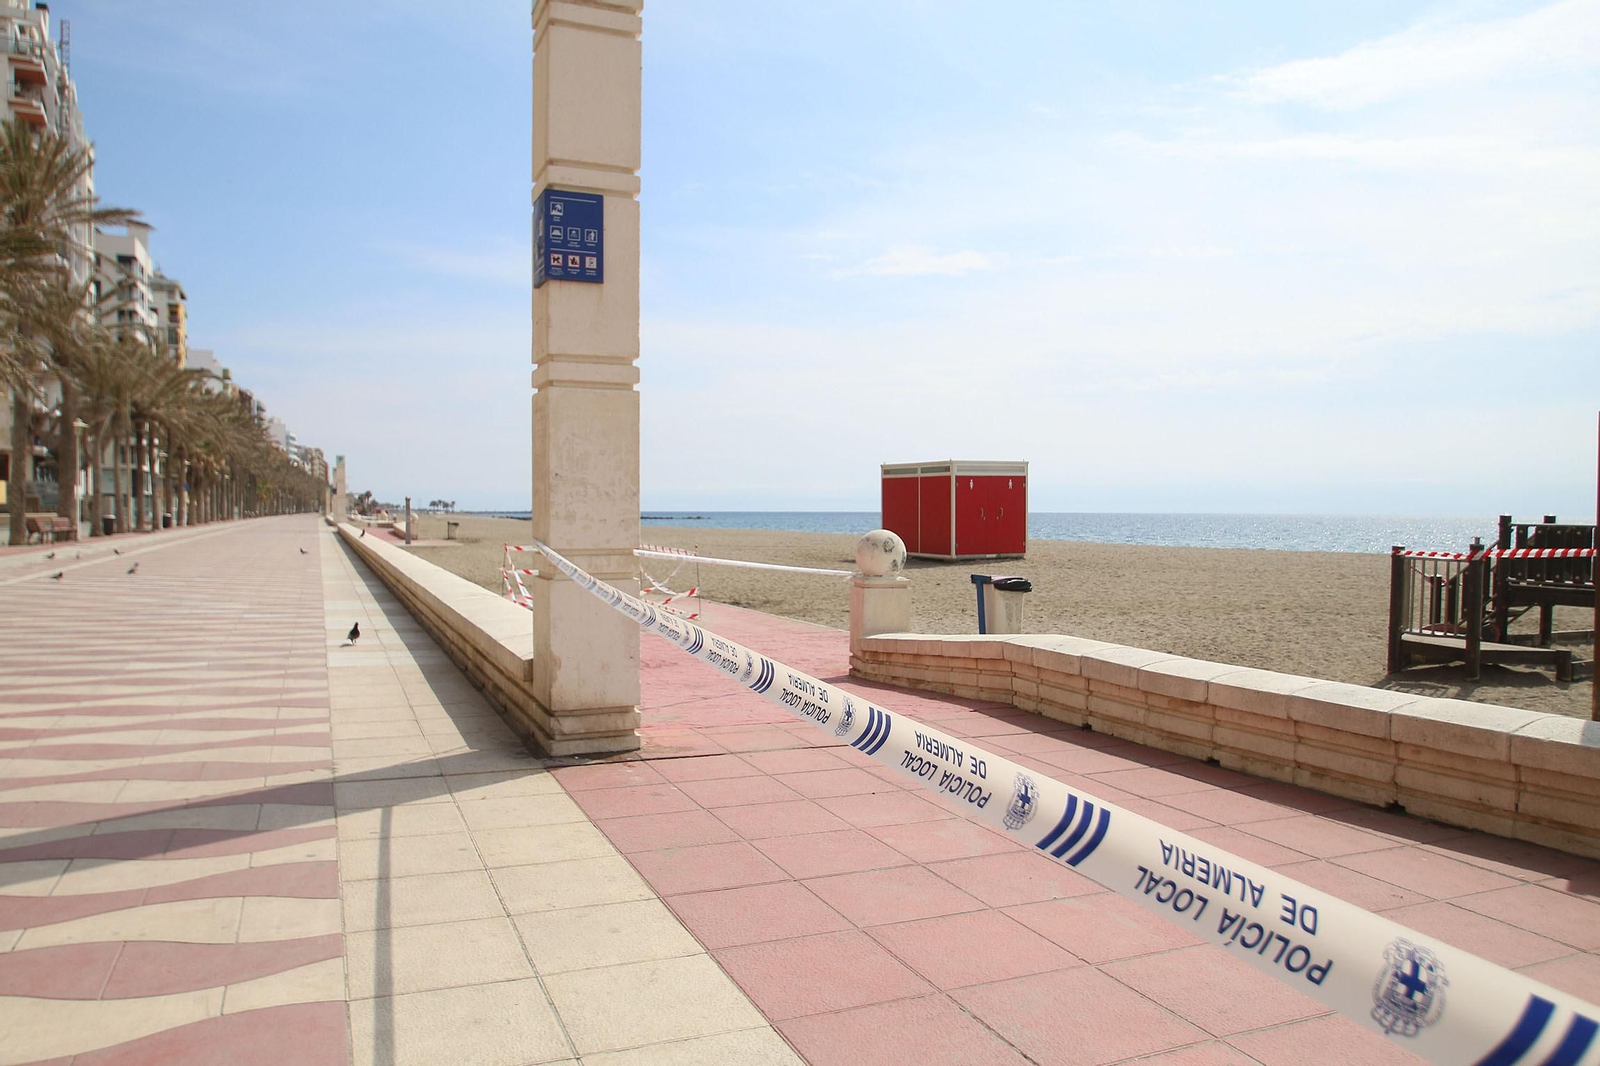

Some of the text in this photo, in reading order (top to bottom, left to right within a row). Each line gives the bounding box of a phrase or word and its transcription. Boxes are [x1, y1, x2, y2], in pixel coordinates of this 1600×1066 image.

[779, 688, 831, 724] POLICÍA LOCAL
[818, 687, 829, 703] DE
[900, 749, 992, 809] POLICÍA LOCAL
[914, 730, 987, 780] DE ALMERIA
[1159, 838, 1318, 936] DE ALMERIA
[1134, 865, 1334, 986] POLICÍA LOCAL
